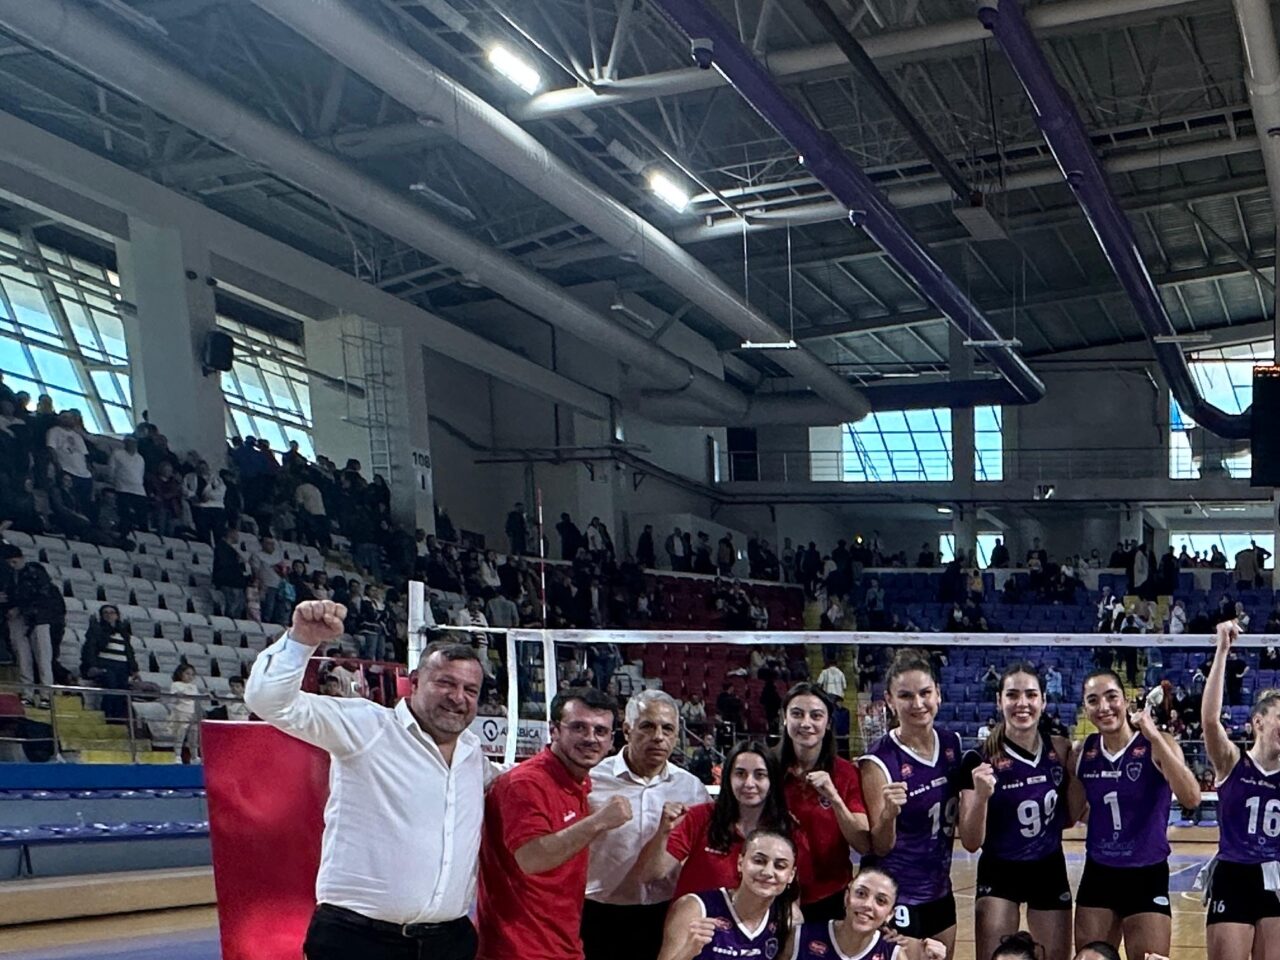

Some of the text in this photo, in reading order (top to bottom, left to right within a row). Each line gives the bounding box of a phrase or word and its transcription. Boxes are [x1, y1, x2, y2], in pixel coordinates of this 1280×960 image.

[501, 727, 540, 739] ABICA
[928, 797, 958, 840] 19
[1017, 789, 1058, 838] 99
[1103, 791, 1122, 831] 1
[895, 905, 910, 927] 9
[1212, 900, 1226, 913] 16
